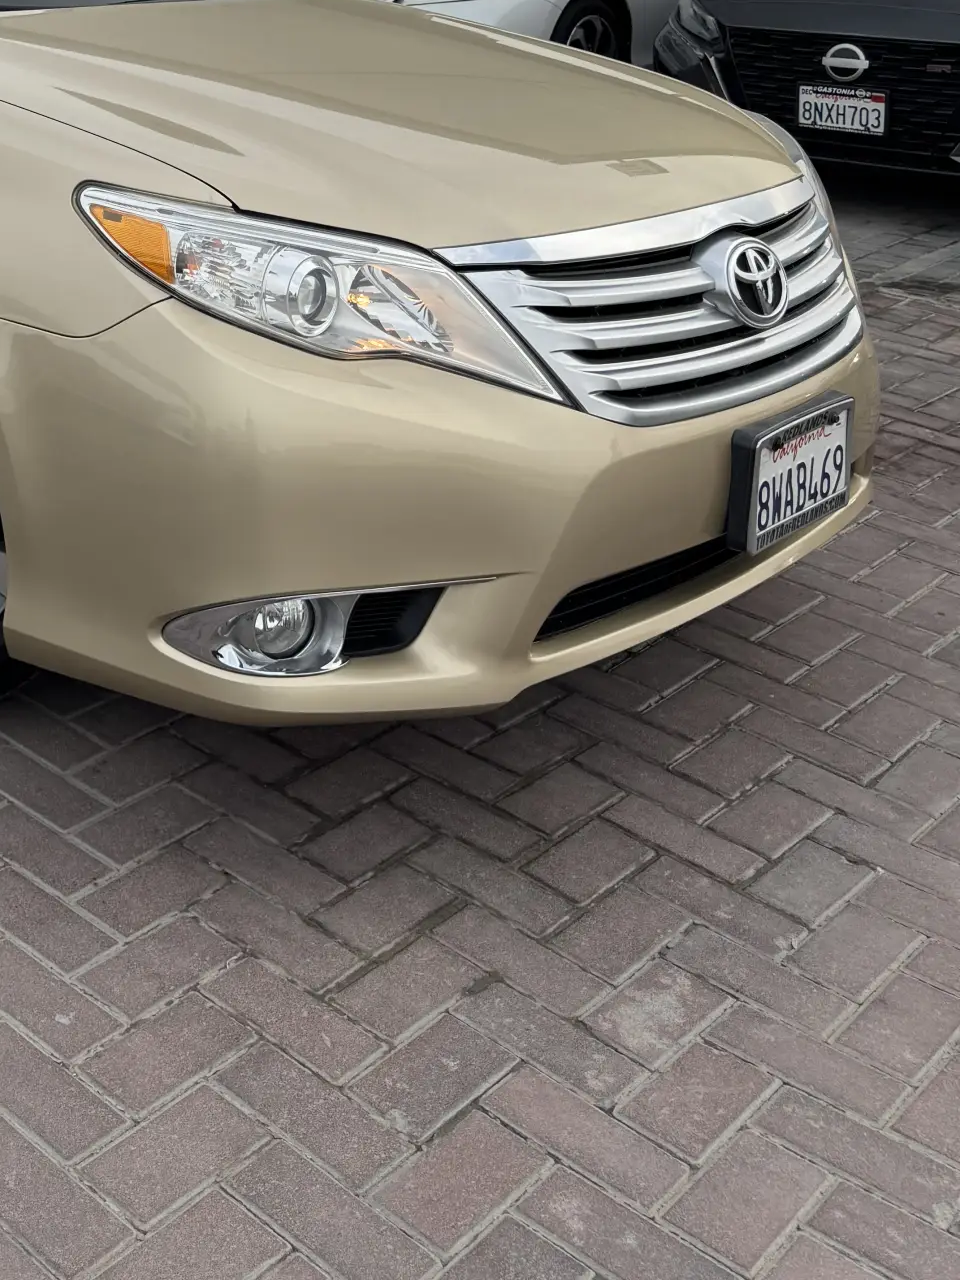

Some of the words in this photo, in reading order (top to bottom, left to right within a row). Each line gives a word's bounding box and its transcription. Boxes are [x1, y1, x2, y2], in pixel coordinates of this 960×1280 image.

[801, 88, 813, 96] DEC
[817, 86, 855, 96] GASTONIA
[802, 100, 882, 130] 8NXH703
[756, 444, 844, 532] 8WAB469
